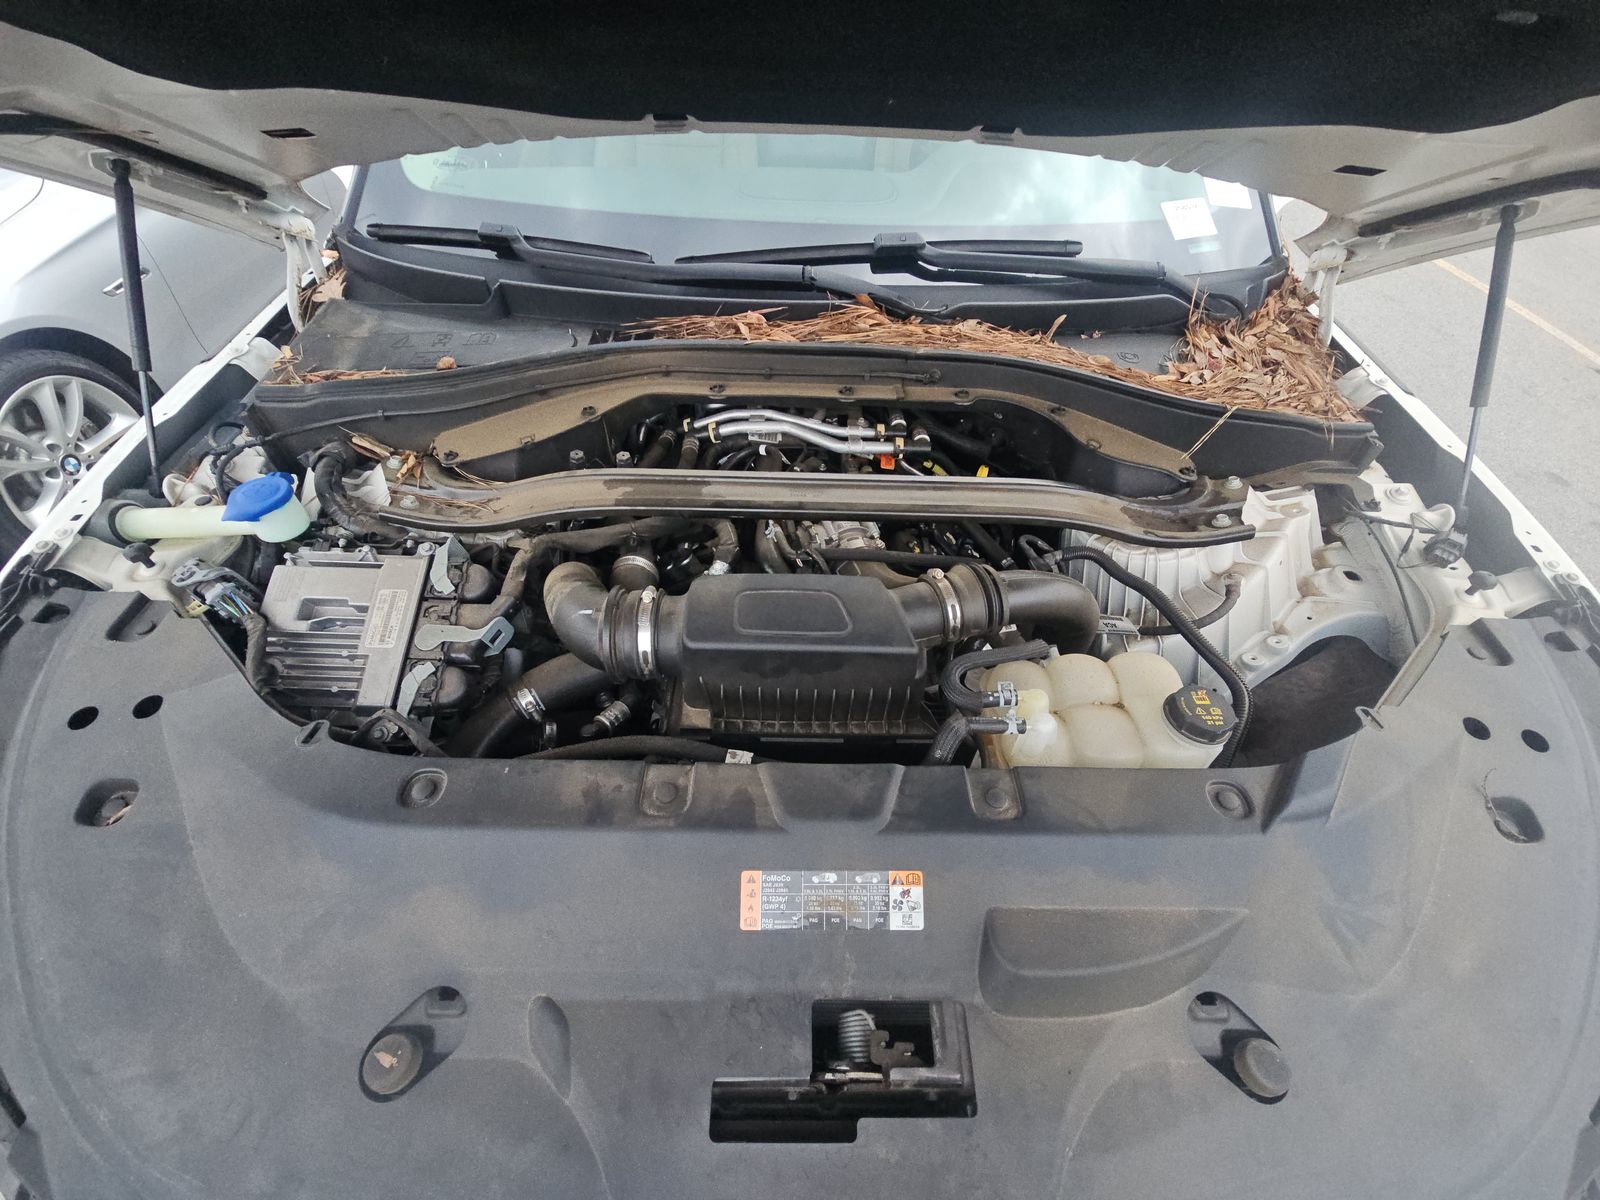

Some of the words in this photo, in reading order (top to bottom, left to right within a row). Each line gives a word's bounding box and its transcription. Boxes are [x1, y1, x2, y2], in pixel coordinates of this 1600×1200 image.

[762, 874, 791, 882] FoMoCo
[762, 895, 788, 903] R-1234yf
[762, 903, 779, 911] (GWP
[779, 903, 786, 911] 4)
